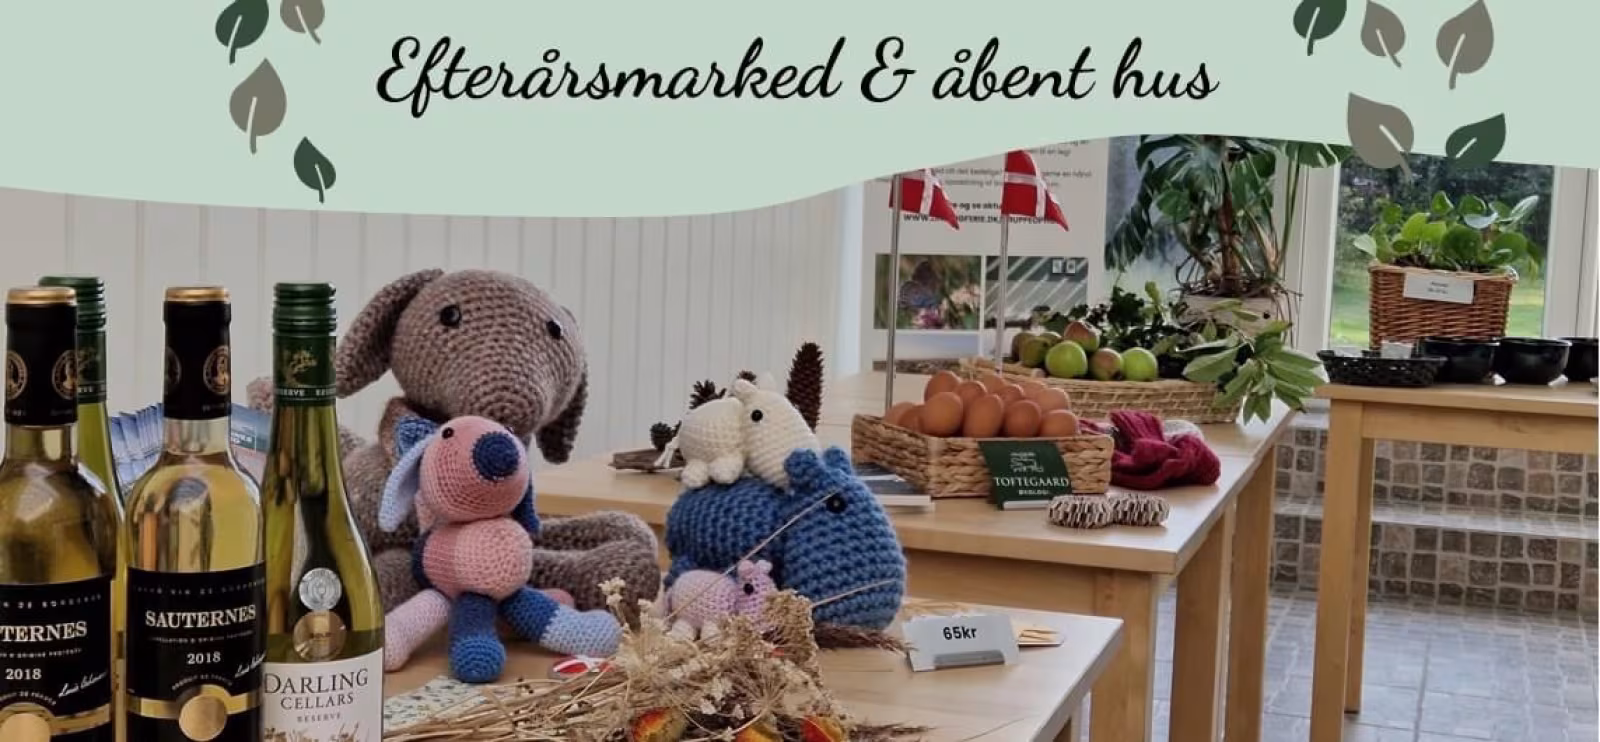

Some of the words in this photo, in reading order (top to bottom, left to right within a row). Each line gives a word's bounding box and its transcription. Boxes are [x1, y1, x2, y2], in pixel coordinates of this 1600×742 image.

[993, 476, 1069, 487] TOFTEGAARD
[145, 604, 257, 628] SAUTERNES
[942, 626, 977, 641] 65kr
[187, 651, 221, 665] 2018
[5, 668, 42, 680] 2018
[264, 668, 369, 694] DARLING
[280, 691, 354, 710] CELLARS
[297, 711, 341, 723] RESERVE
